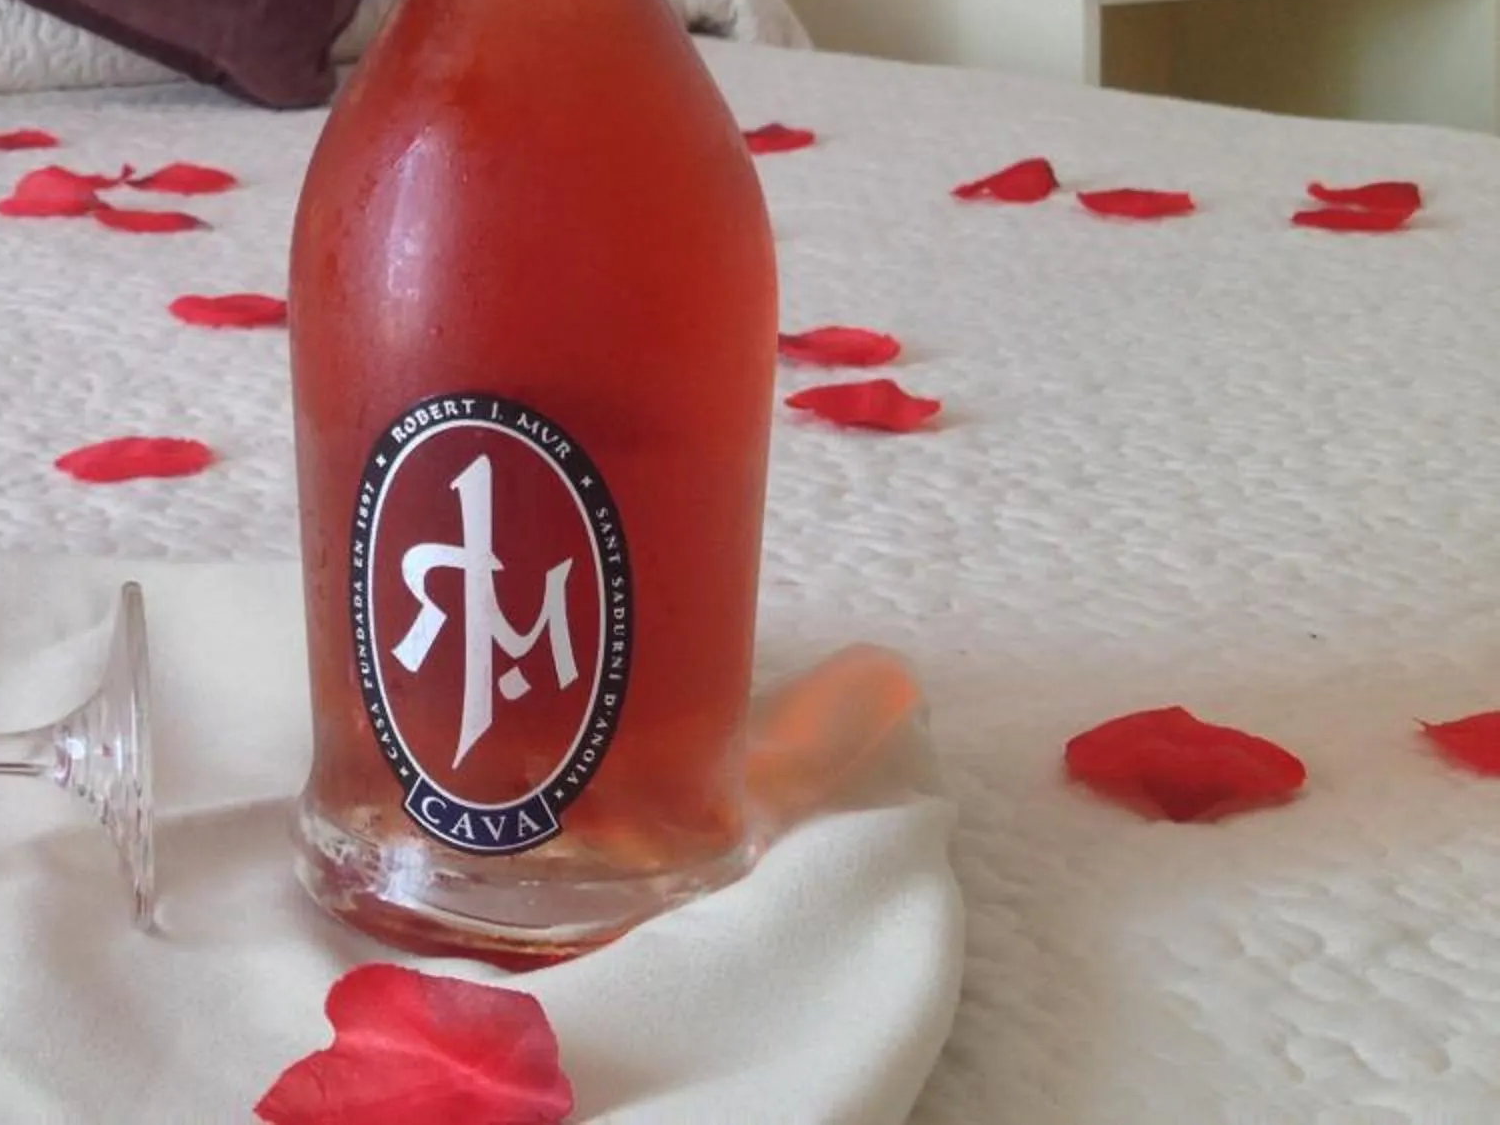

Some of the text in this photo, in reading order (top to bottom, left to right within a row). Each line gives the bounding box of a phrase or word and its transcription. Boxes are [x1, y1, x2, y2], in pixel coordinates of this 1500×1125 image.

[391, 399, 476, 444] ROBERT
[596, 506, 622, 564] SANT
[353, 481, 399, 760] CASA FUNDADA EN 1897
[420, 795, 542, 843] CAVA
